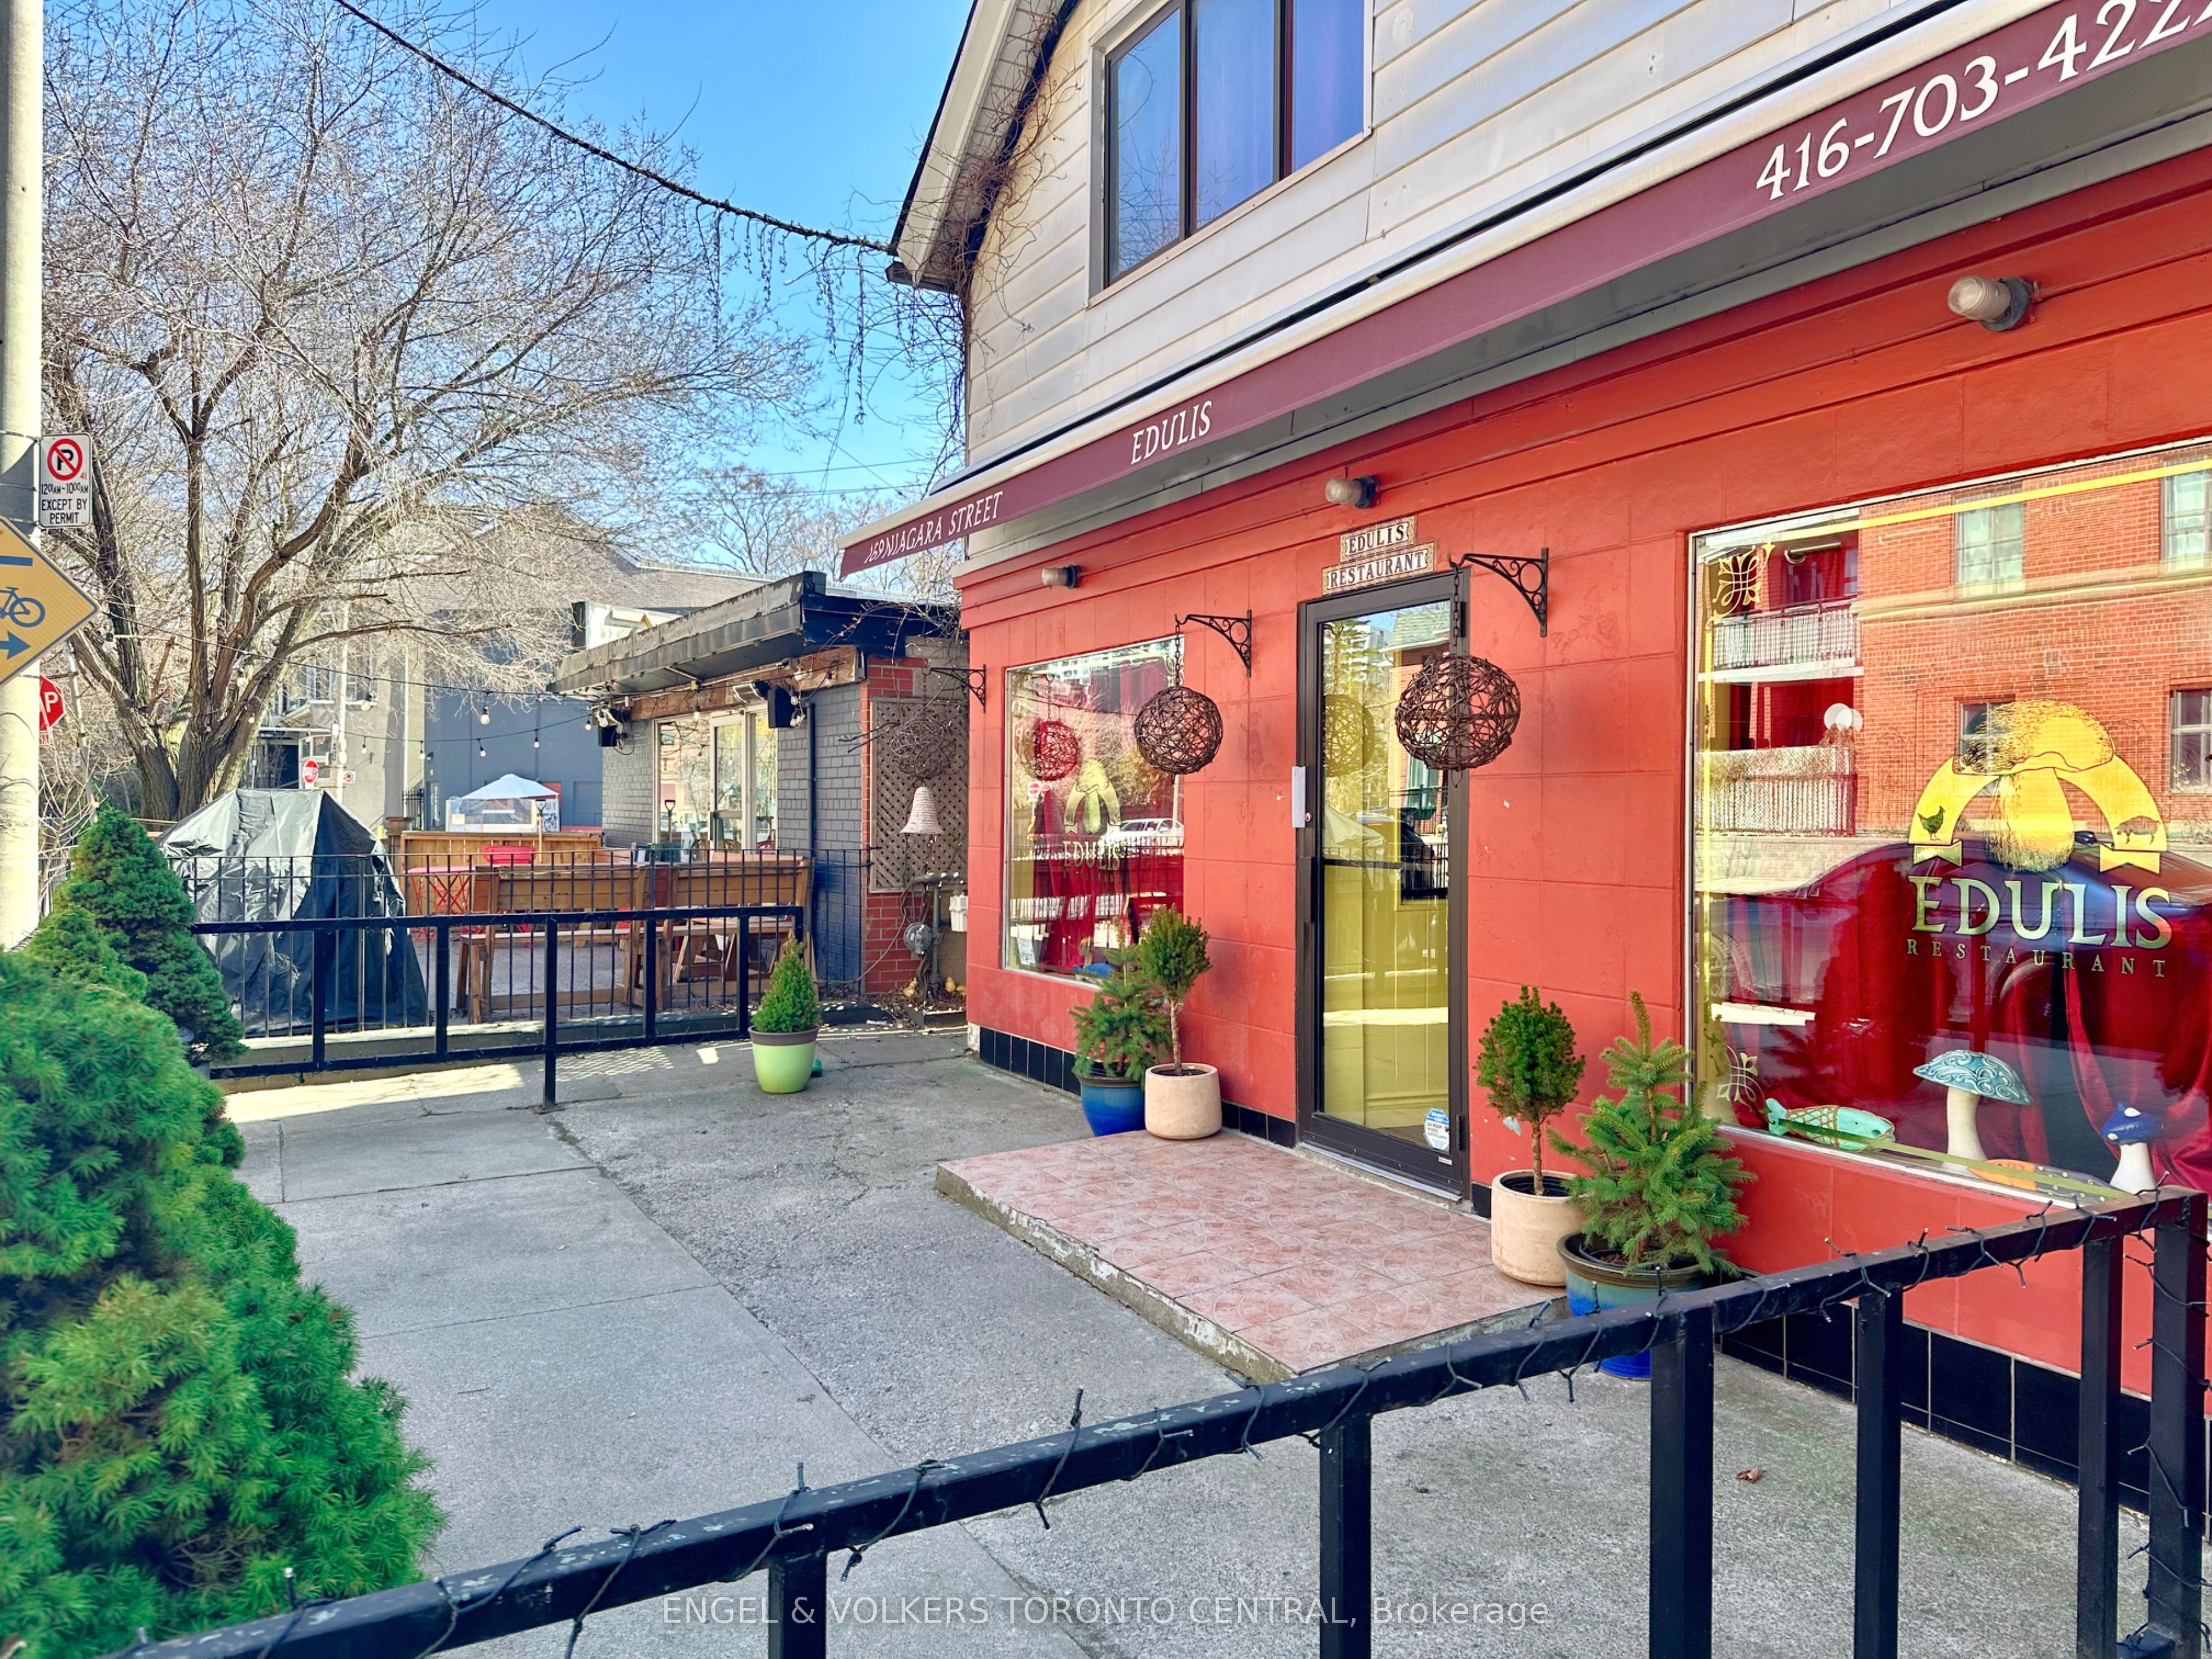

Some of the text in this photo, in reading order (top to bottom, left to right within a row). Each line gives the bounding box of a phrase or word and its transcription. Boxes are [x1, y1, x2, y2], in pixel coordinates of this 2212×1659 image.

[1756, 0, 2212, 200] 416-703-422
[1130, 401, 1212, 464] EDULIS
[41, 498, 88, 510] EXCEPT BY
[50, 512, 79, 524] PERMIT
[948, 491, 1003, 536] STREET
[1349, 525, 1406, 554] EDULIS
[1330, 551, 1425, 588] RESTAURANT
[1063, 840, 1121, 871] EDULIS
[1907, 875, 2173, 949] EDULIS
[1907, 938, 2166, 978] RESTAURANT
